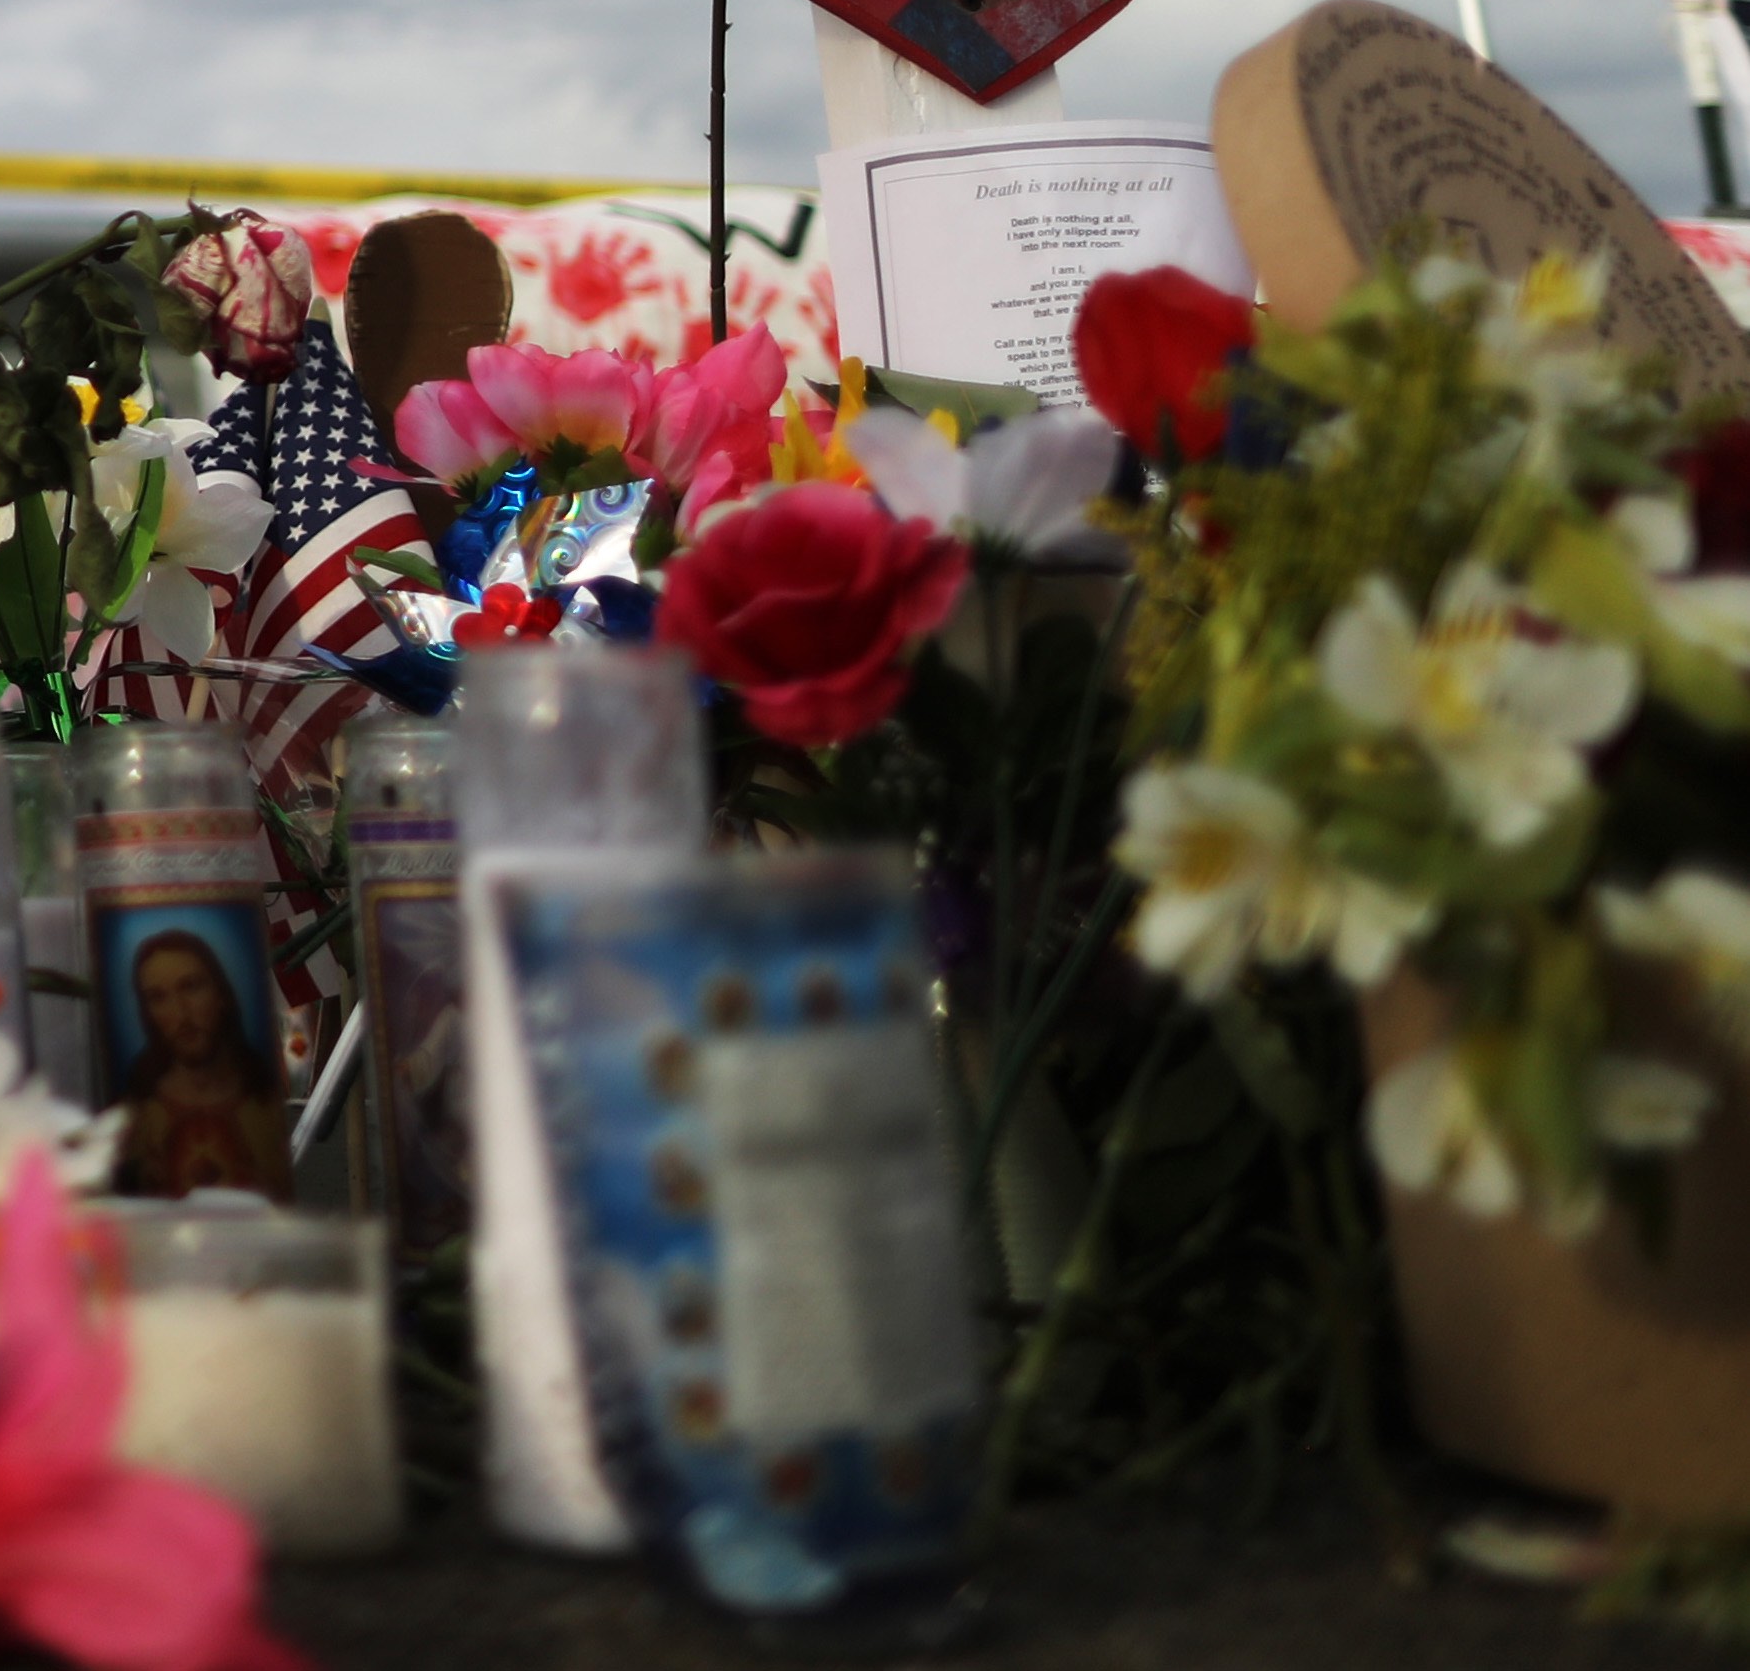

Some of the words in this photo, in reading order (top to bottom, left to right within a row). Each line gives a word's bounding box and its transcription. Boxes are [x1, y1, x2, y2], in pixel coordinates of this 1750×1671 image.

[975, 179, 1023, 200] Death
[1028, 178, 1042, 194] is
[1048, 177, 1120, 196] nothing
[1125, 179, 1144, 192] at
[1148, 177, 1174, 192] all
[1010, 216, 1039, 228] Death
[1042, 215, 1052, 226] is
[1055, 214, 1100, 226] nothing
[1102, 215, 1114, 224] at
[1013, 230, 1035, 241] have
[1037, 227, 1061, 239] only
[1064, 227, 1107, 239] slipped
[1110, 228, 1140, 239] away
[1020, 242, 1039, 252] into
[1041, 240, 1059, 249] the
[1062, 240, 1088, 249] next
[1090, 240, 1125, 249] room.
[1058, 266, 1075, 275] am
[1030, 281, 1047, 292] and
[1049, 279, 1070, 291] you
[991, 297, 1038, 309] whatever
[1039, 296, 1051, 304] we
[1054, 293, 1080, 302] were
[1056, 307, 1070, 315] we
[994, 339, 1015, 349] Call
[1017, 338, 1033, 347] me
[1035, 336, 1047, 347] by
[1049, 334, 1063, 344] my
[1007, 350, 1038, 363] speak
[1039, 349, 1050, 359] to
[1051, 348, 1066, 357] me
[1019, 362, 1049, 374] which
[1050, 361, 1069, 372] you
[1024, 378, 1037, 387] no
[1040, 374, 1082, 386] differenc
[1060, 387, 1074, 396] no
